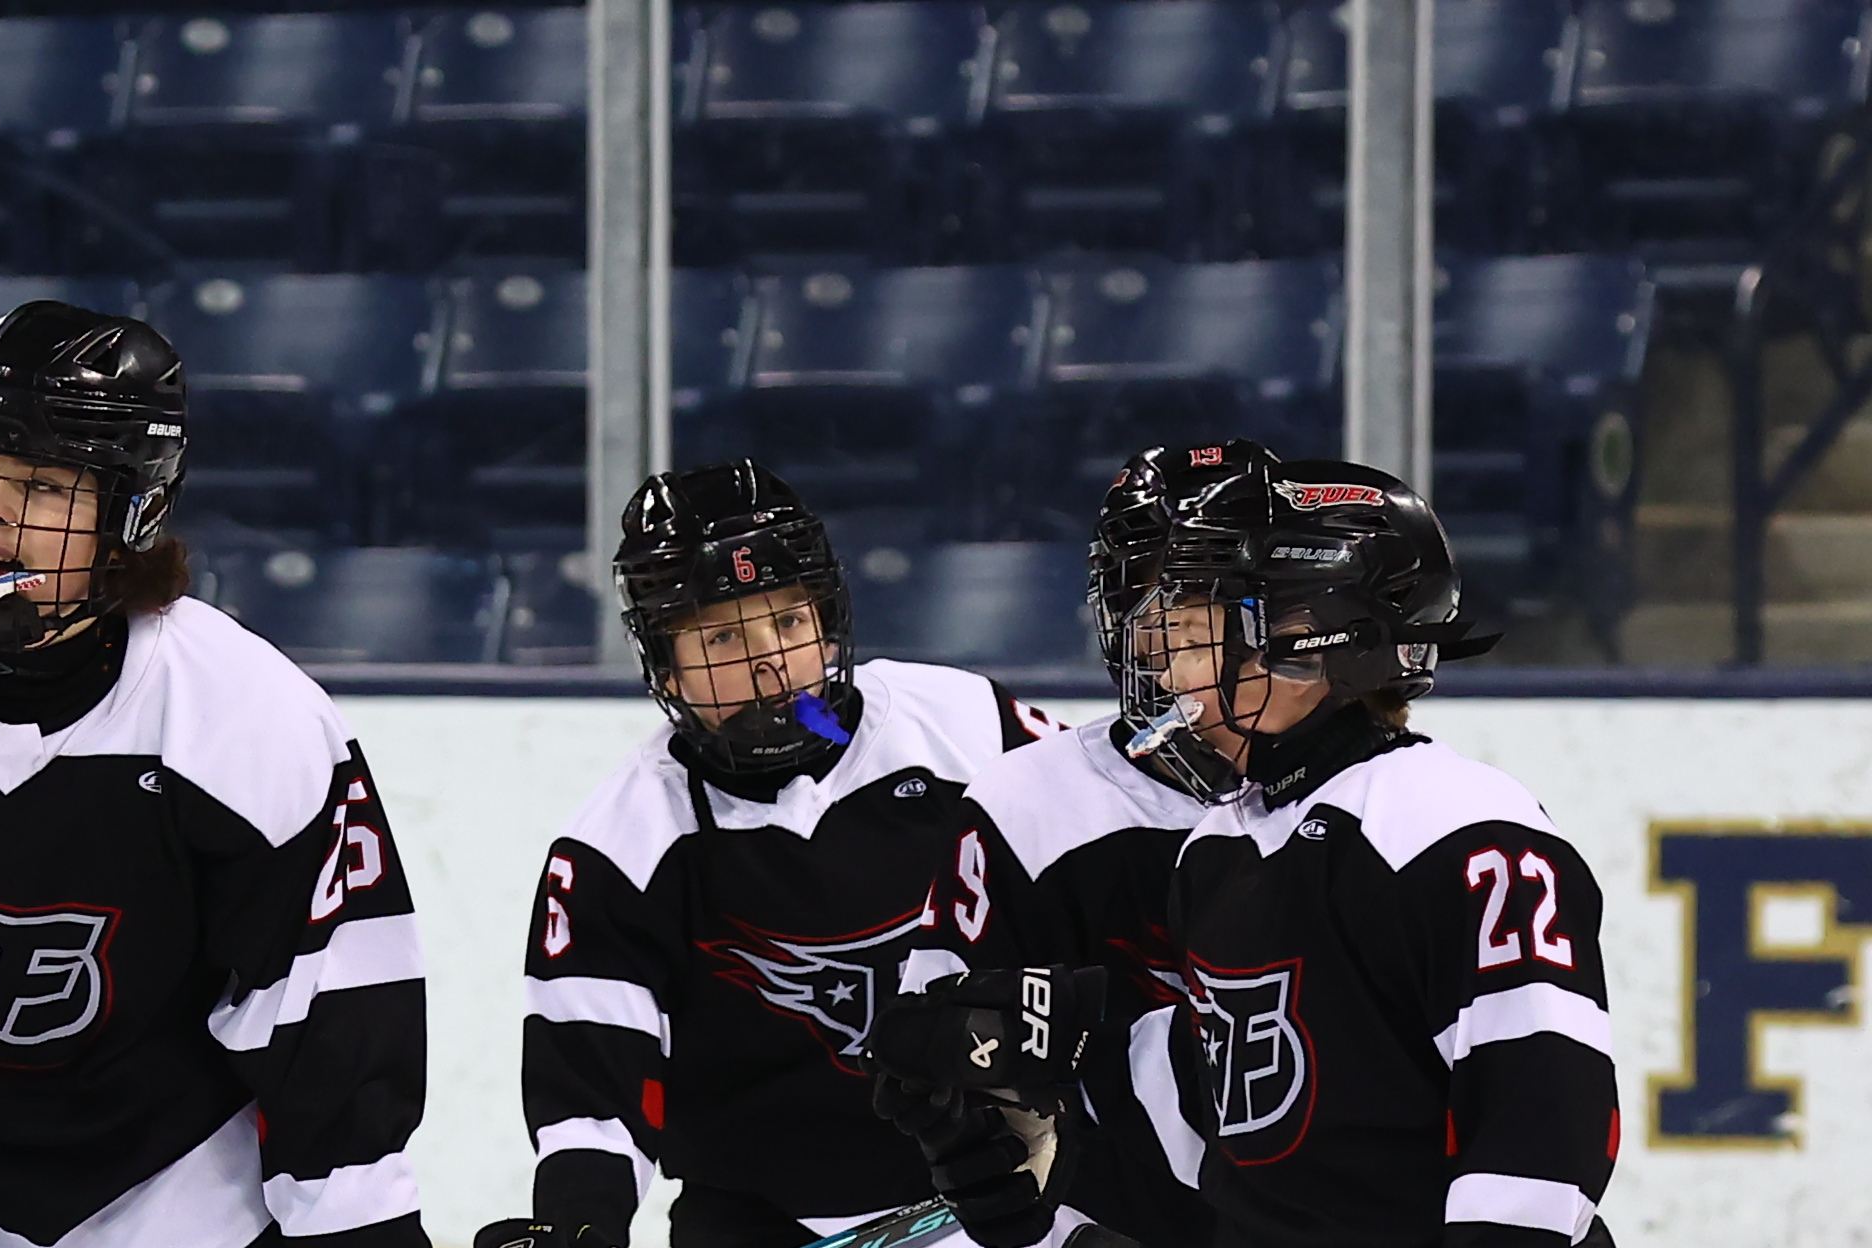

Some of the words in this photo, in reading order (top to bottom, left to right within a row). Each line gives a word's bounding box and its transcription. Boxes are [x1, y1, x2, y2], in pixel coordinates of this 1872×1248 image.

[147, 423, 182, 438] BAUER
[1190, 446, 1223, 467] 19
[1294, 482, 1384, 510] FUEL
[732, 547, 756, 583] 6
[308, 776, 387, 924] 25
[541, 853, 576, 960] 6
[1464, 845, 1575, 972] 22
[1021, 967, 1051, 1060] ER
[1646, 818, 1872, 1153] F
